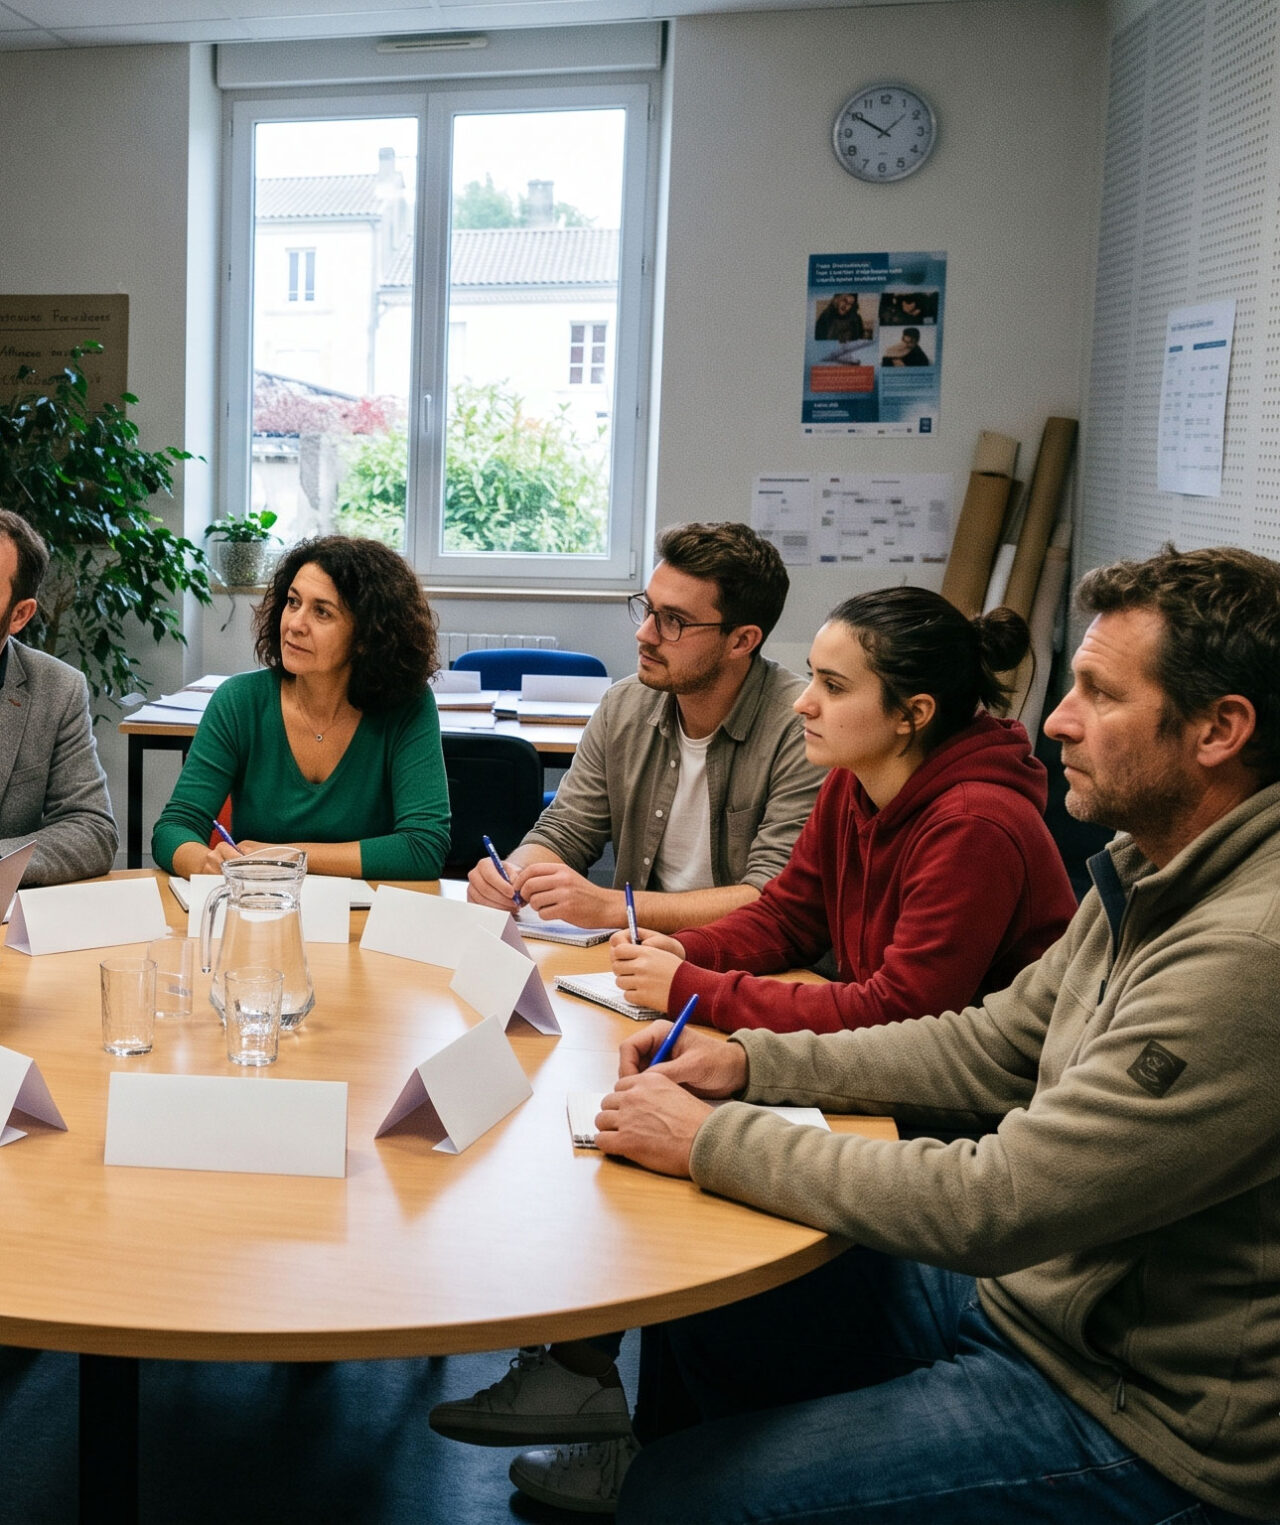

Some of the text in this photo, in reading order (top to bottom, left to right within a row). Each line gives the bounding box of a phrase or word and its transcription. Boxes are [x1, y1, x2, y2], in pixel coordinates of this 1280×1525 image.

[864, 99, 873, 109] 11
[880, 94, 892, 105] 12
[912, 109, 921, 120] 2
[847, 145, 857, 156] 8
[861, 159, 870, 169] 7
[877, 162, 887, 173] 6
[896, 157, 905, 168] 5
